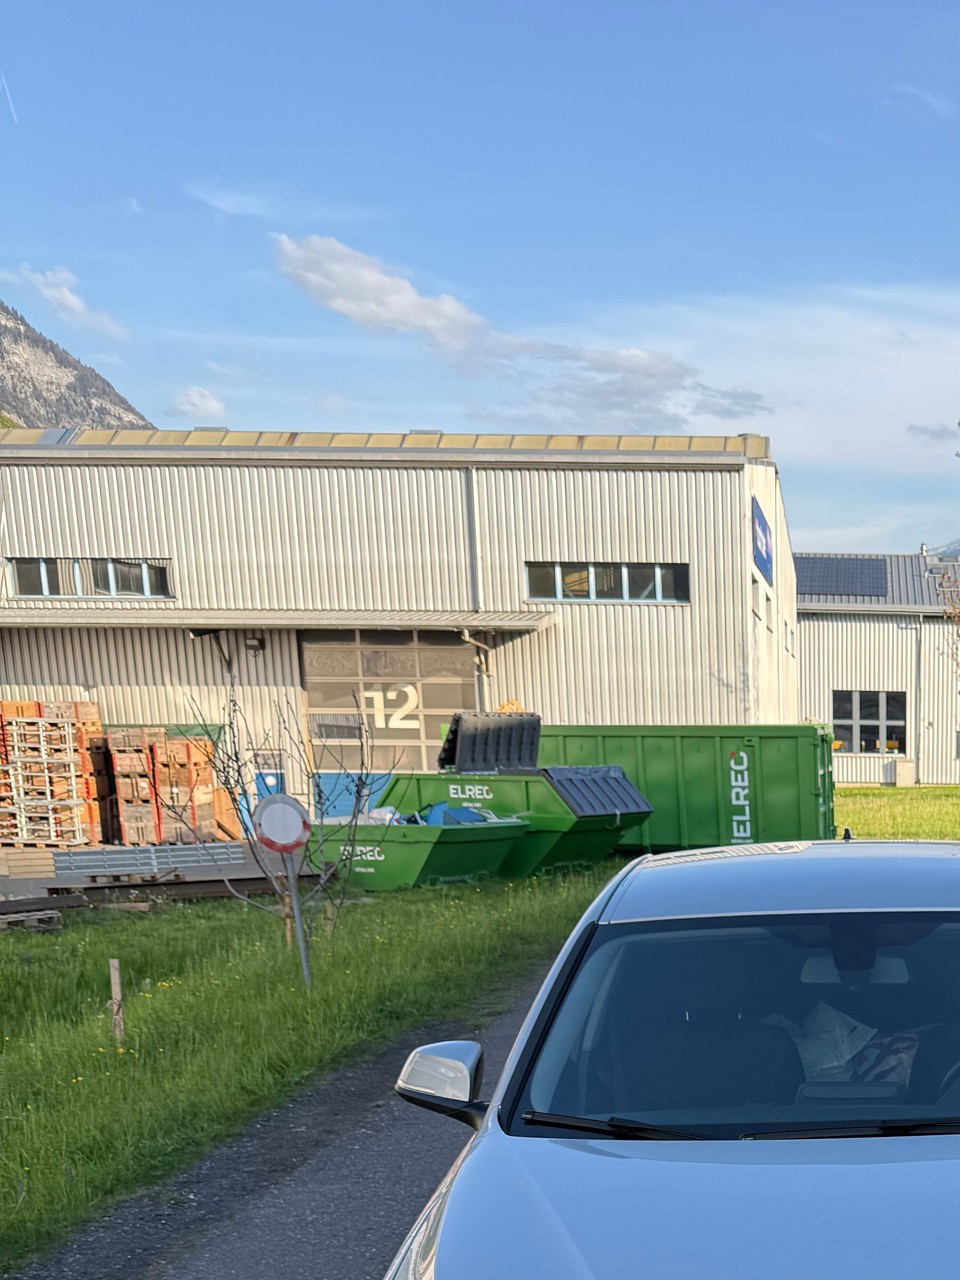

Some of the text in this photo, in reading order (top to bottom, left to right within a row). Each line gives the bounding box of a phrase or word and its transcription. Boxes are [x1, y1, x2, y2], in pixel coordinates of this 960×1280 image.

[364, 684, 421, 729] 12
[448, 784, 494, 799] ELREC
[730, 751, 751, 837] ELREC
